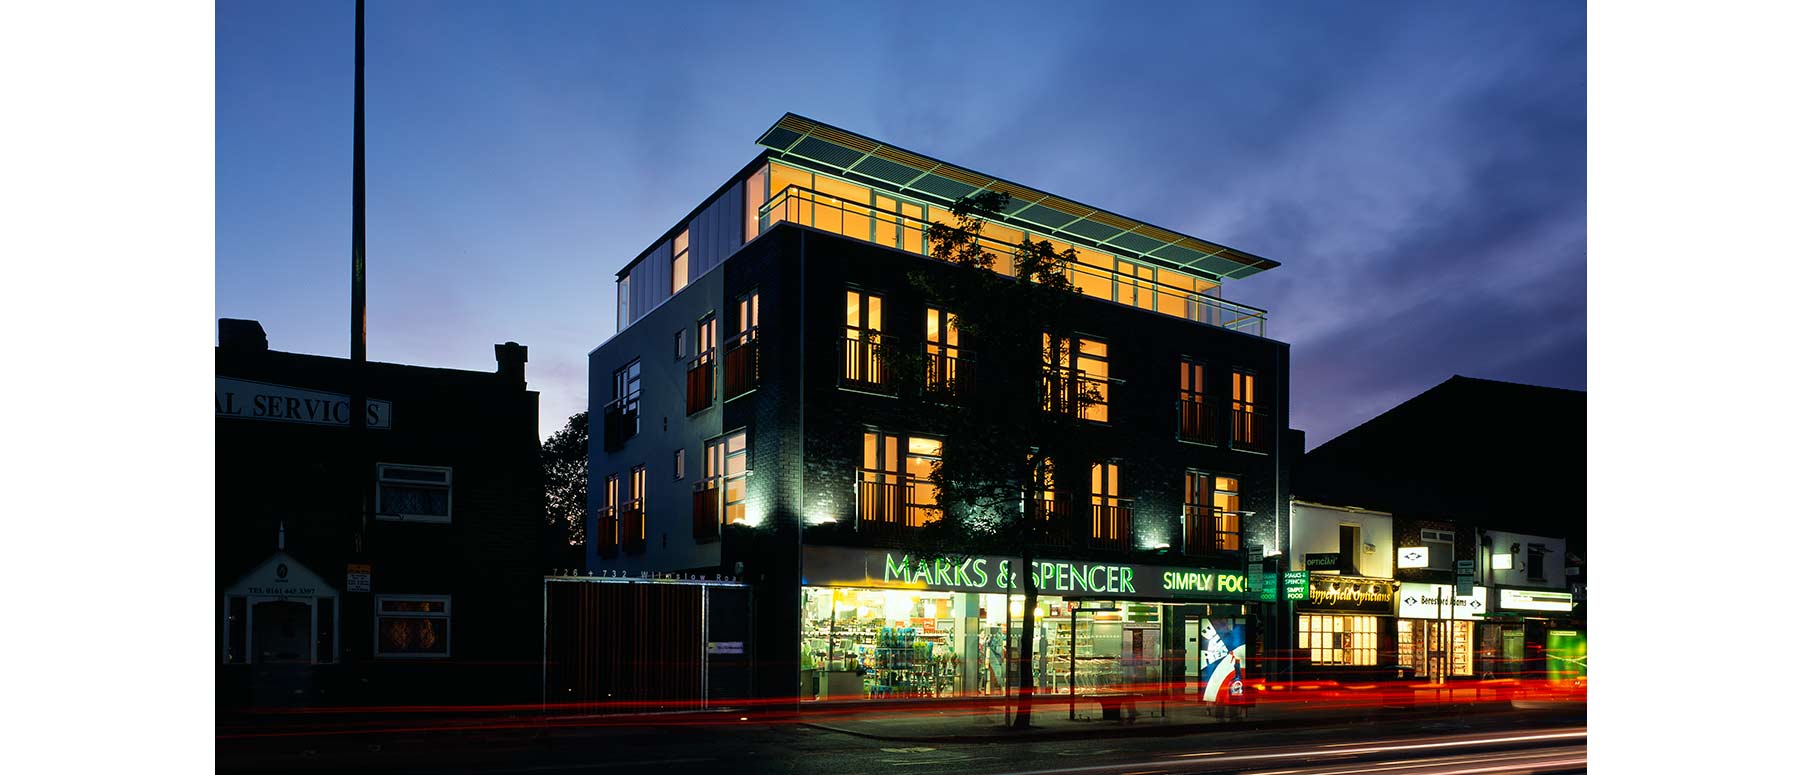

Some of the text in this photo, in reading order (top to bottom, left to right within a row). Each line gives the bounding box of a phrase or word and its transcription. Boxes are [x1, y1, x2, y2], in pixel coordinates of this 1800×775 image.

[253, 393, 380, 426] SERVICS
[553, 568, 578, 577] 726
[602, 569, 627, 578] 732
[884, 553, 1136, 593] MARKS & SPENCER
[1163, 572, 1212, 591] SIMPLY
